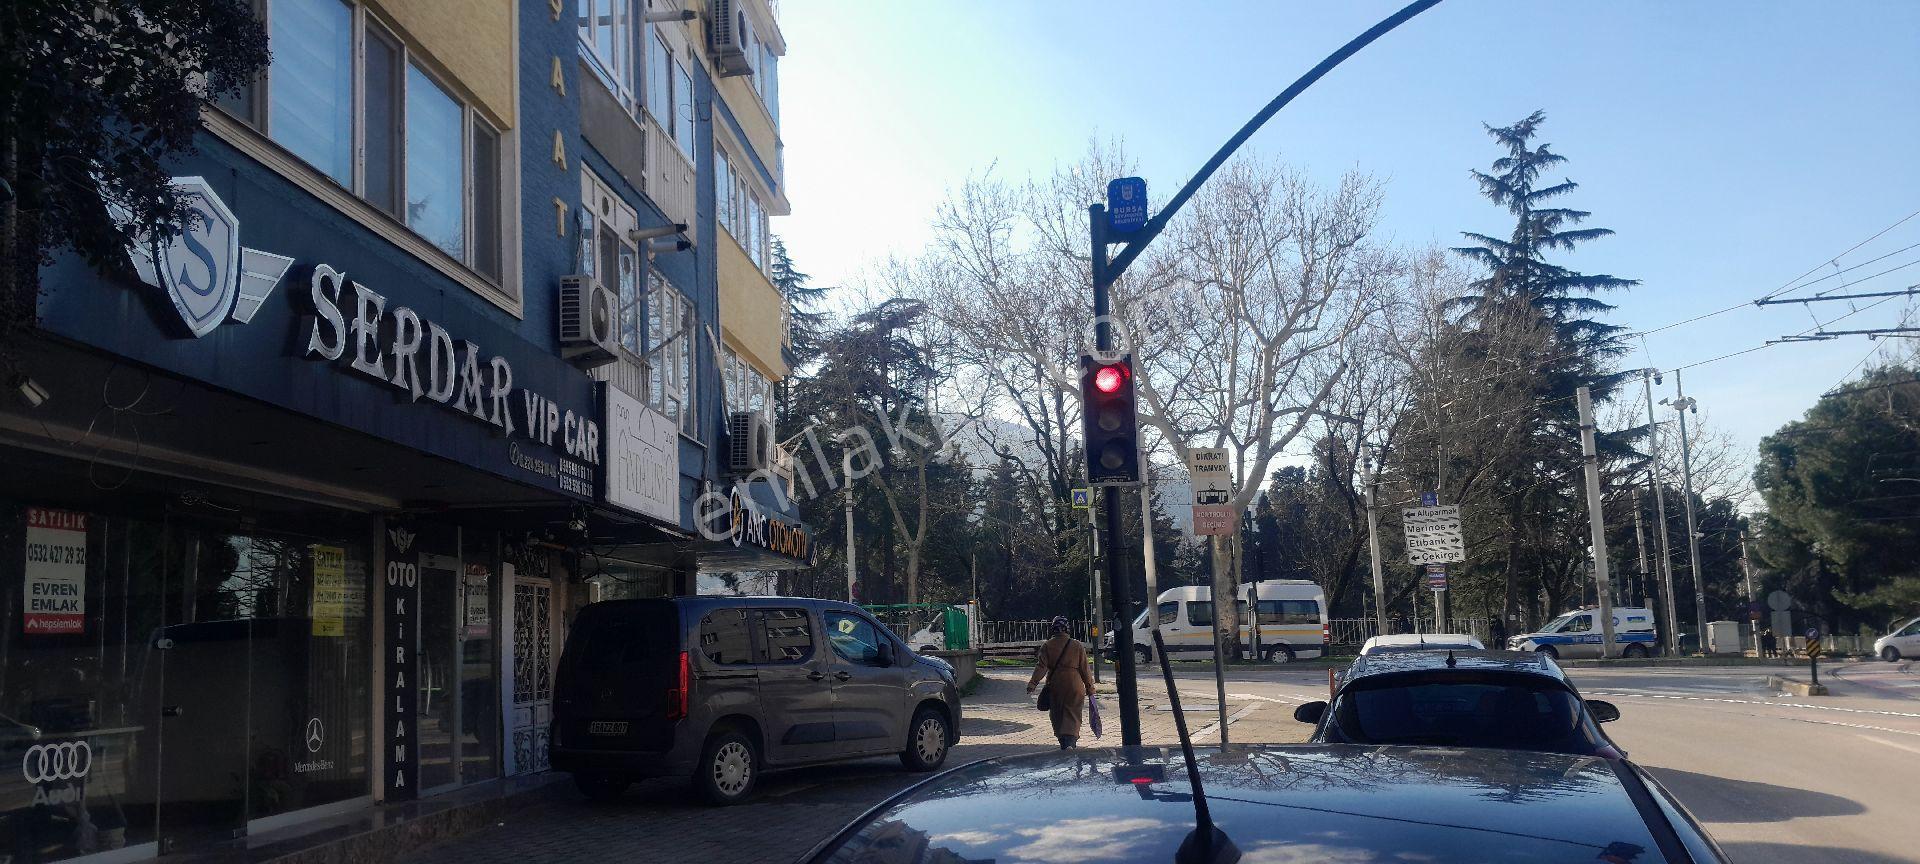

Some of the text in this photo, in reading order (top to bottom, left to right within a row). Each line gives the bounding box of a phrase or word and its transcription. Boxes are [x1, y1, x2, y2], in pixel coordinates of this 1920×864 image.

[1113, 205, 1143, 215] BURSA
[306, 263, 600, 467] SERDAR VIP CAR
[1194, 464, 1227, 473] TRAMVAY
[28, 509, 86, 529] SATILIK
[746, 508, 767, 548] ANC
[1407, 523, 1447, 533] Merinos
[1409, 538, 1447, 548] Etibank
[27, 543, 48, 563] 0532
[49, 544, 63, 564] 427
[75, 547, 85, 565] 32
[1421, 551, 1460, 563] Çekirge
[387, 560, 416, 588] OTO
[32, 582, 78, 597] EVREN
[31, 598, 79, 612] EMLAK
[39, 617, 83, 632] hepsiemlak
[32, 783, 82, 808] Audi
